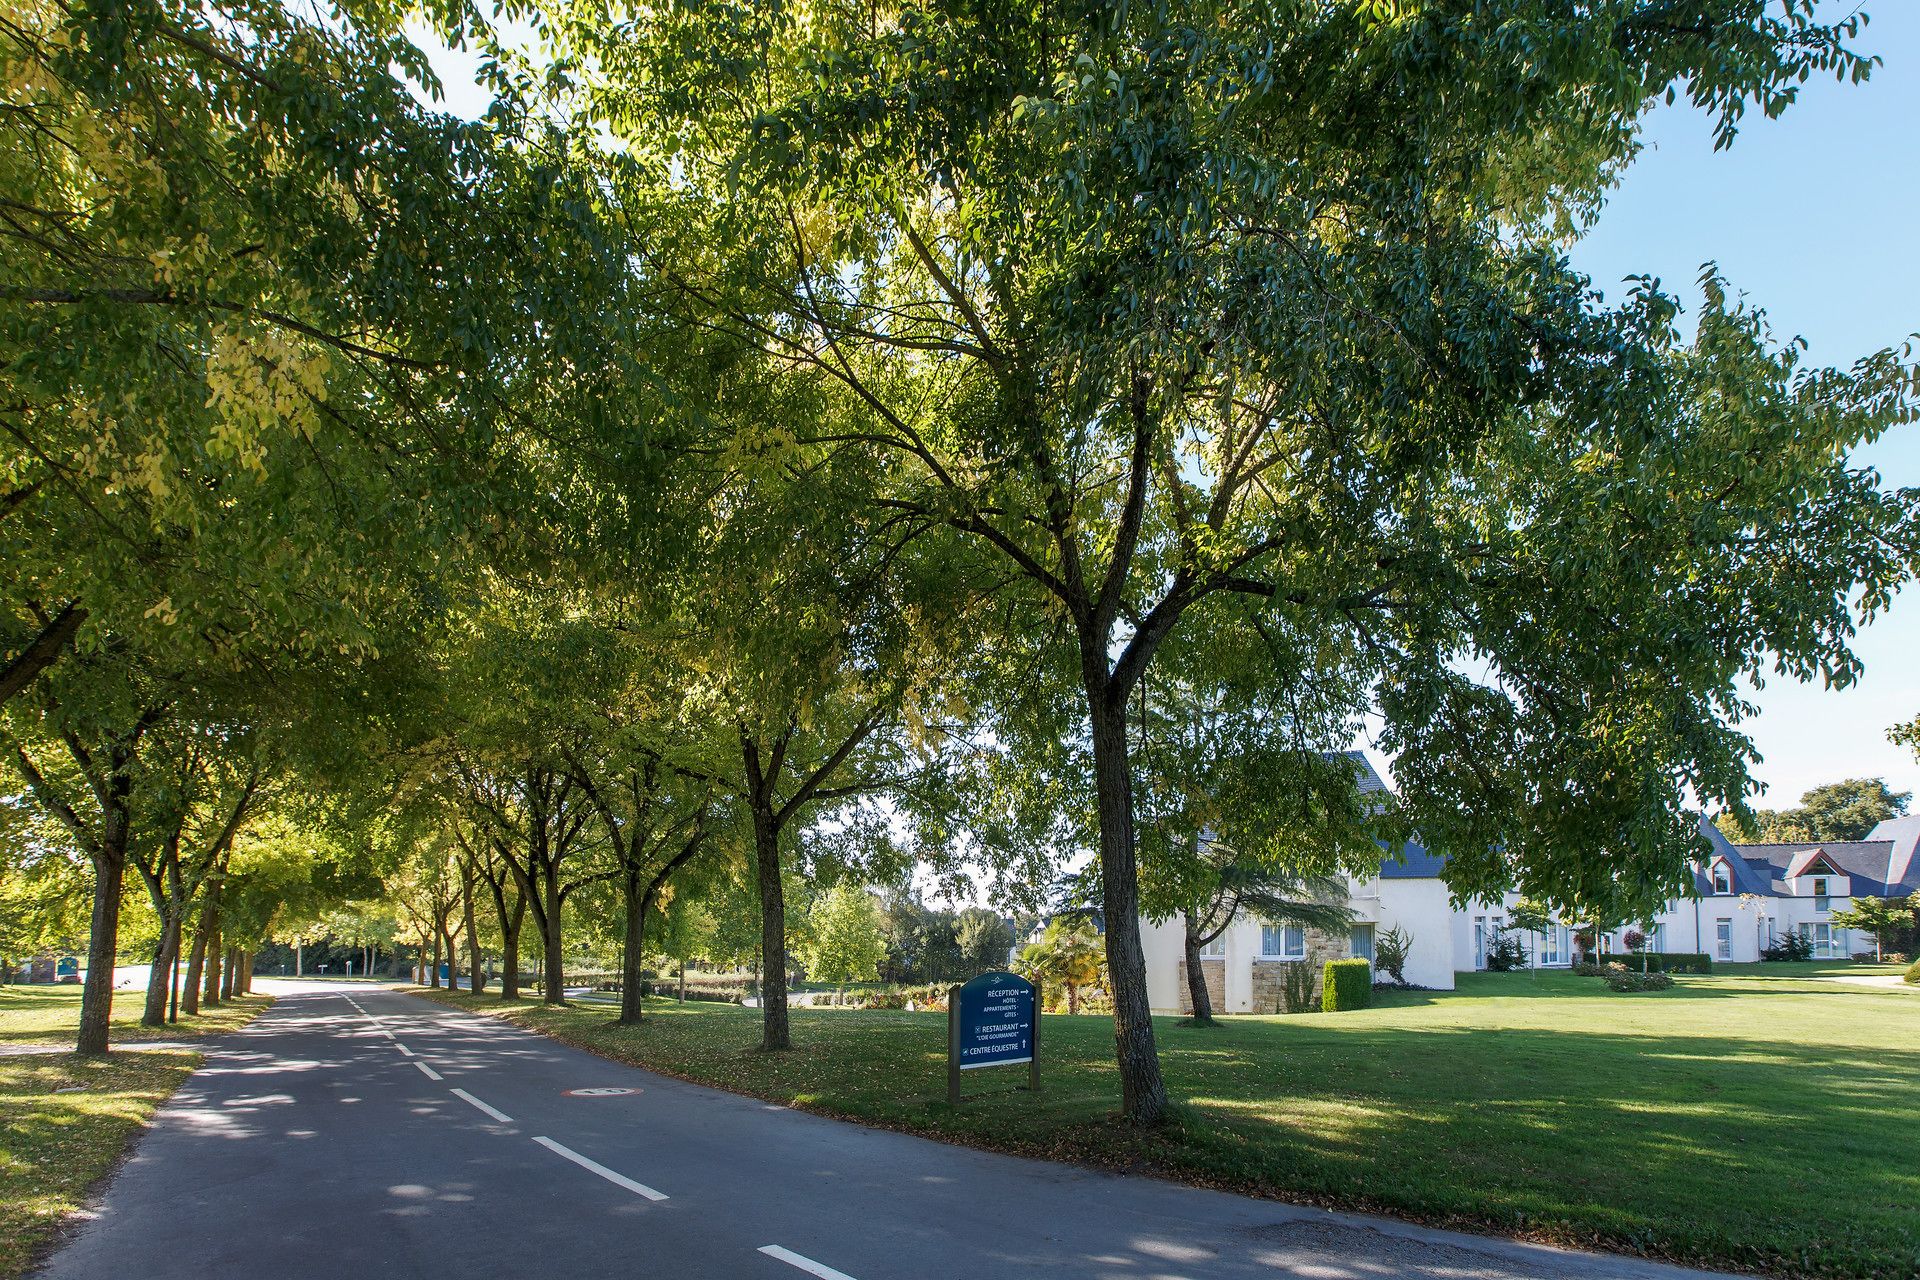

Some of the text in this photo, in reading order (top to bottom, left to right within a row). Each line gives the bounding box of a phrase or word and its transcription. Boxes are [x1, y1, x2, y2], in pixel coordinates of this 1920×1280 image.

[982, 1023, 1019, 1032] RESTAURANT
[970, 1043, 1018, 1055] CENTRE ÉQUESTRE
